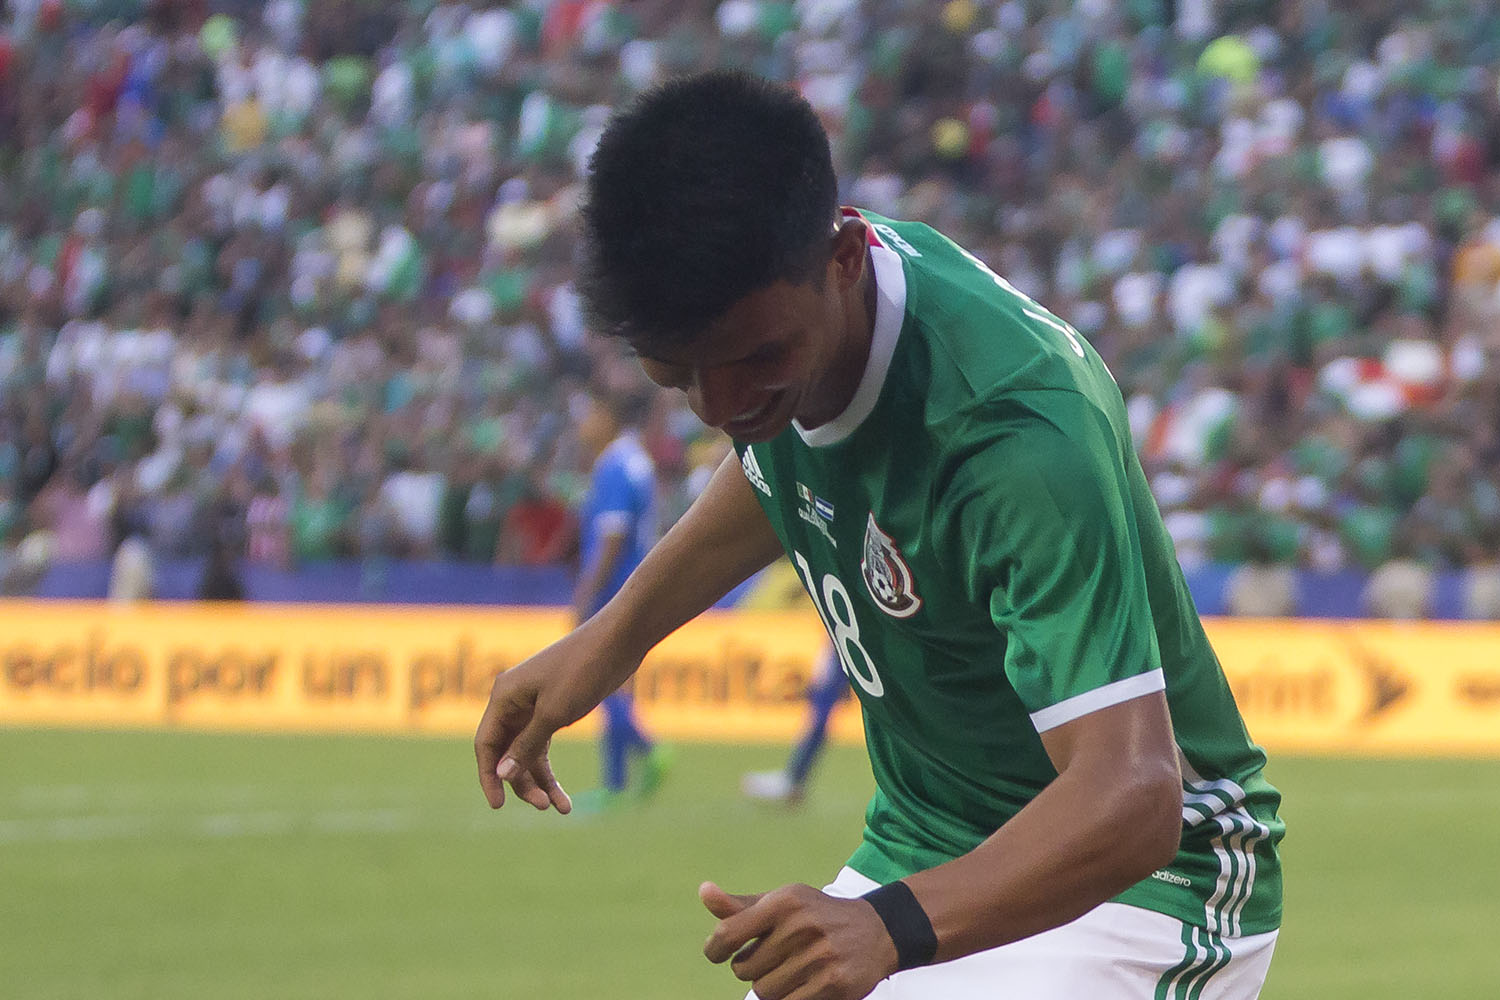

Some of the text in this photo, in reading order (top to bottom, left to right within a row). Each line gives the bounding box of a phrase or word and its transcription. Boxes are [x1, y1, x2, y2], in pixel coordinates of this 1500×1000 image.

[794, 549, 885, 697] 18
[168, 646, 279, 721] por
[303, 649, 391, 698] un
[1151, 870, 1191, 887] adizero
